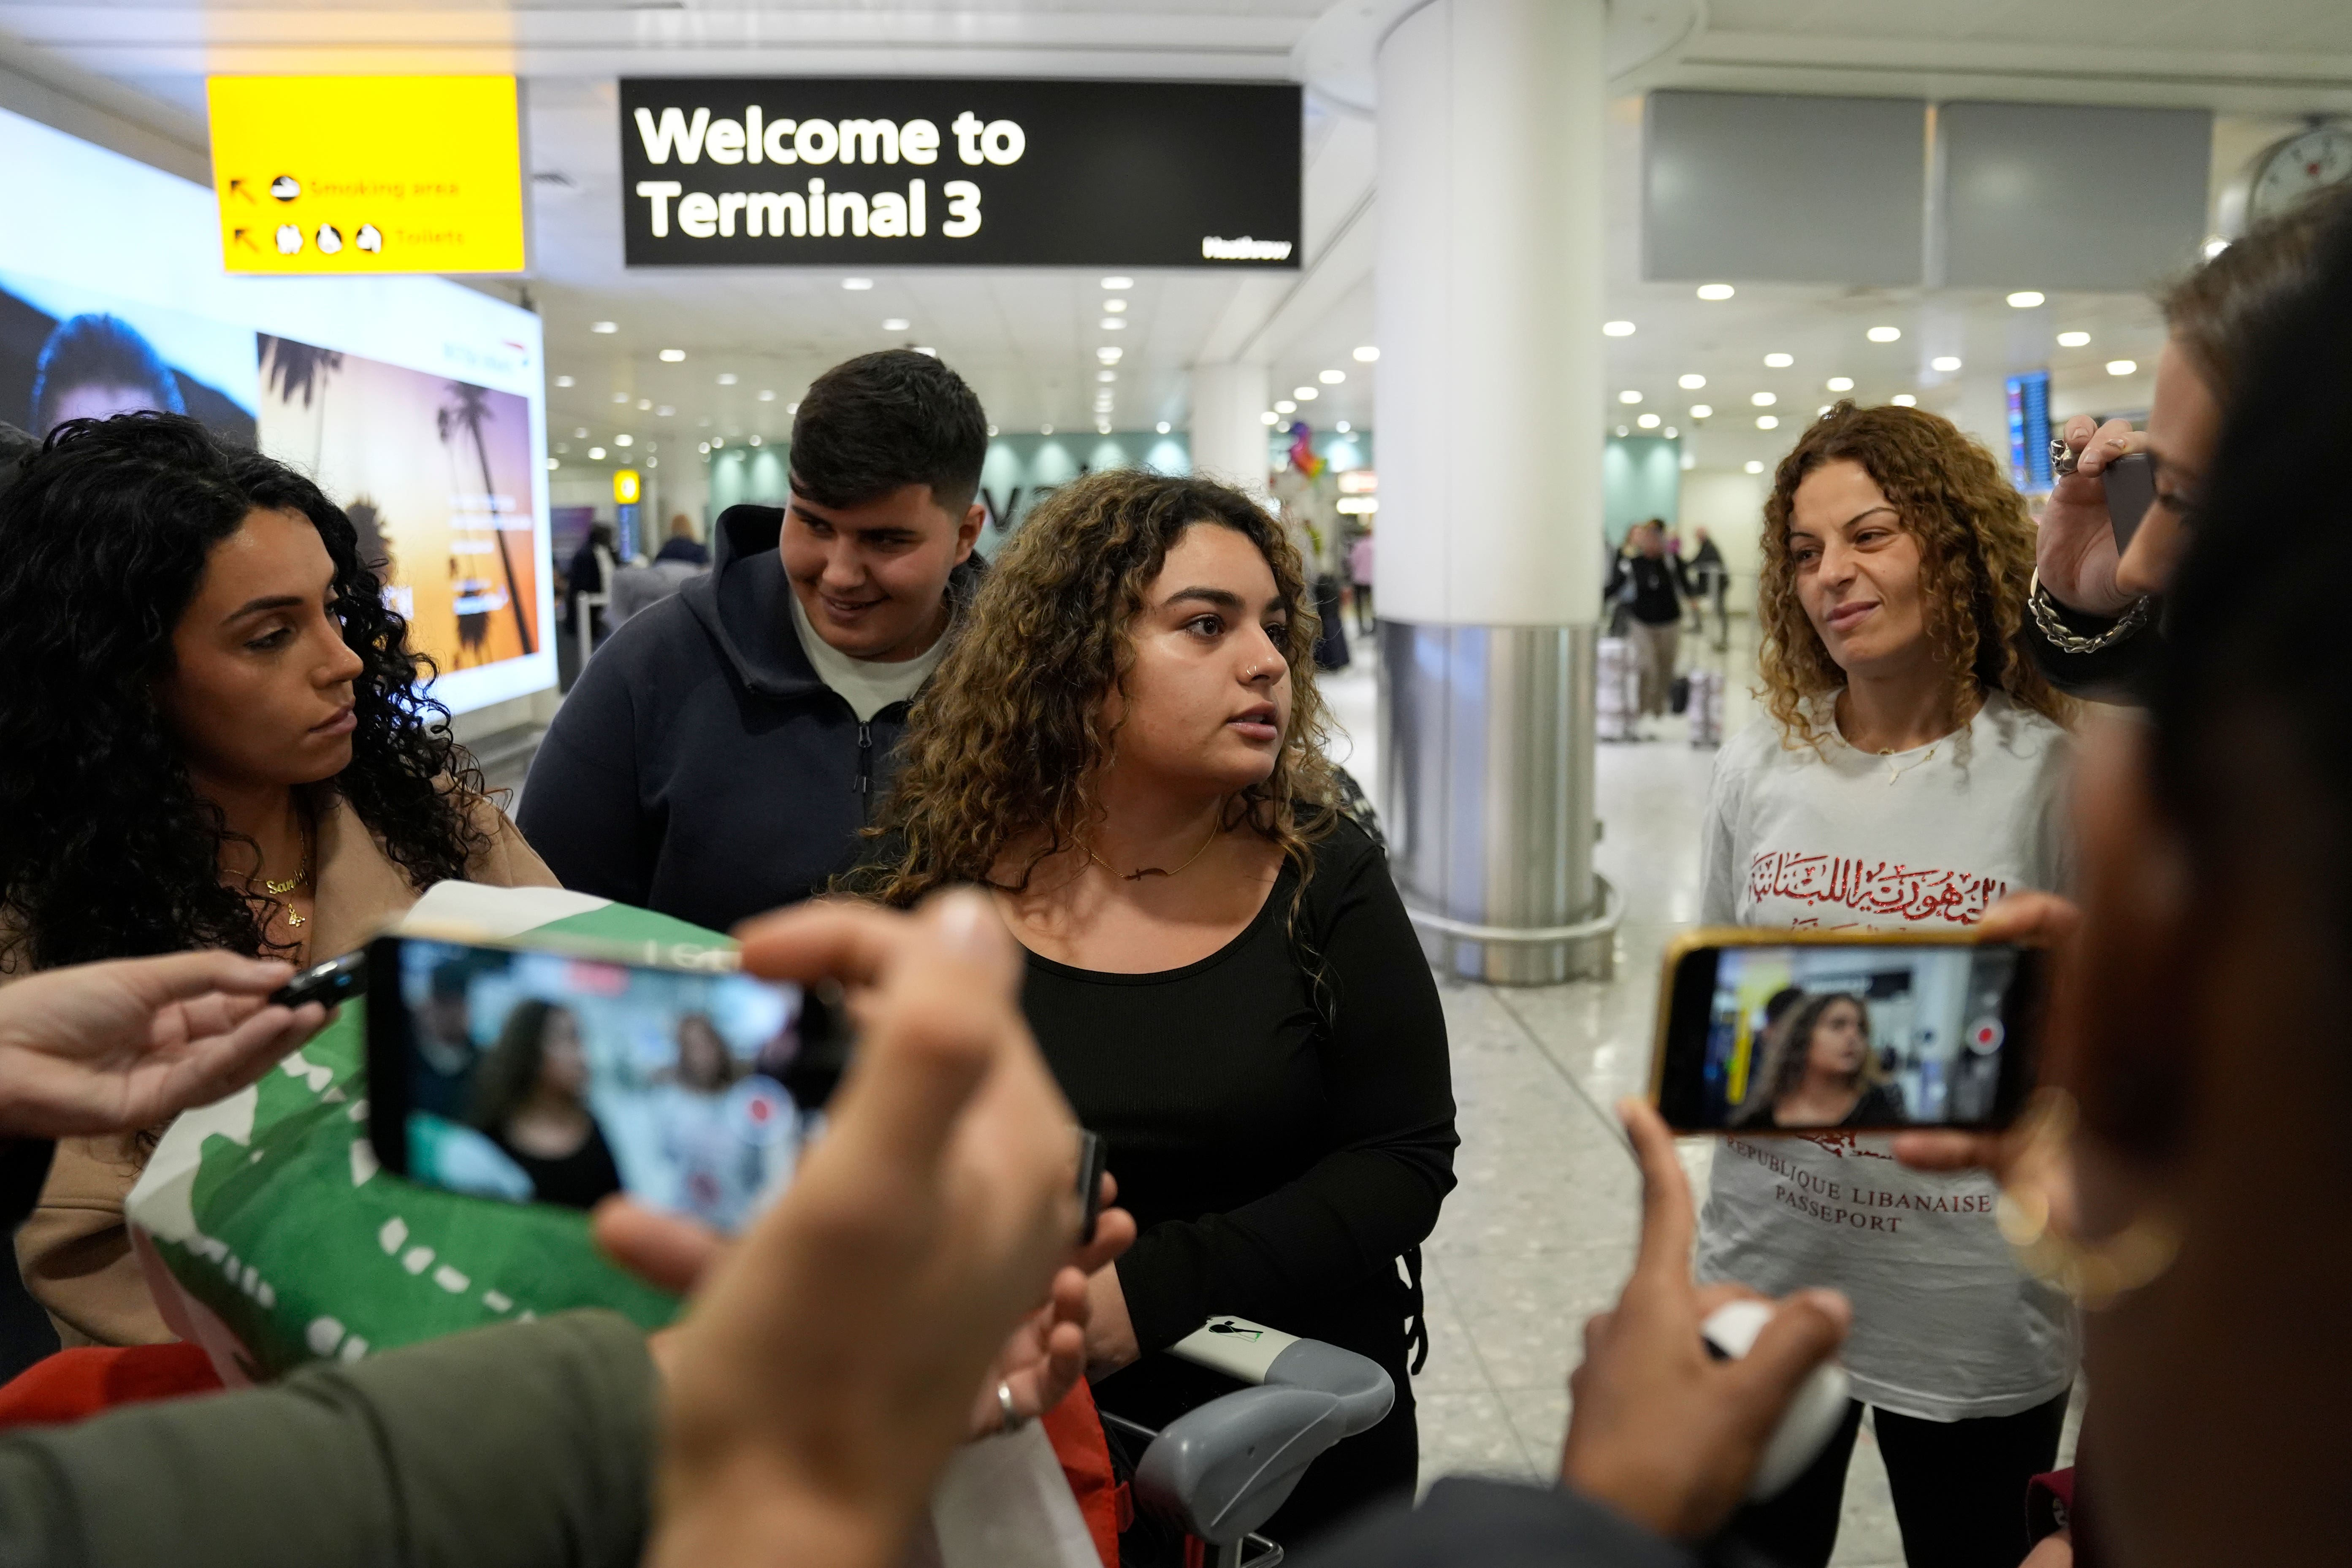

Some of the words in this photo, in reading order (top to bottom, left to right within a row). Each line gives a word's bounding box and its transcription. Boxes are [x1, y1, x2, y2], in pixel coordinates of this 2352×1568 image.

[634, 105, 940, 165] Welcome
[951, 112, 1026, 165] to
[310, 181, 404, 200] Smoking
[413, 182, 460, 196] area
[636, 177, 926, 238] Terminal
[942, 180, 982, 238] 3
[395, 229, 464, 246] Toilets
[1727, 1135, 1841, 1200] REPUBLIQUE
[1852, 1187, 1993, 1213] LIBANAISE
[1776, 1184, 1902, 1233] PASSEPORT
